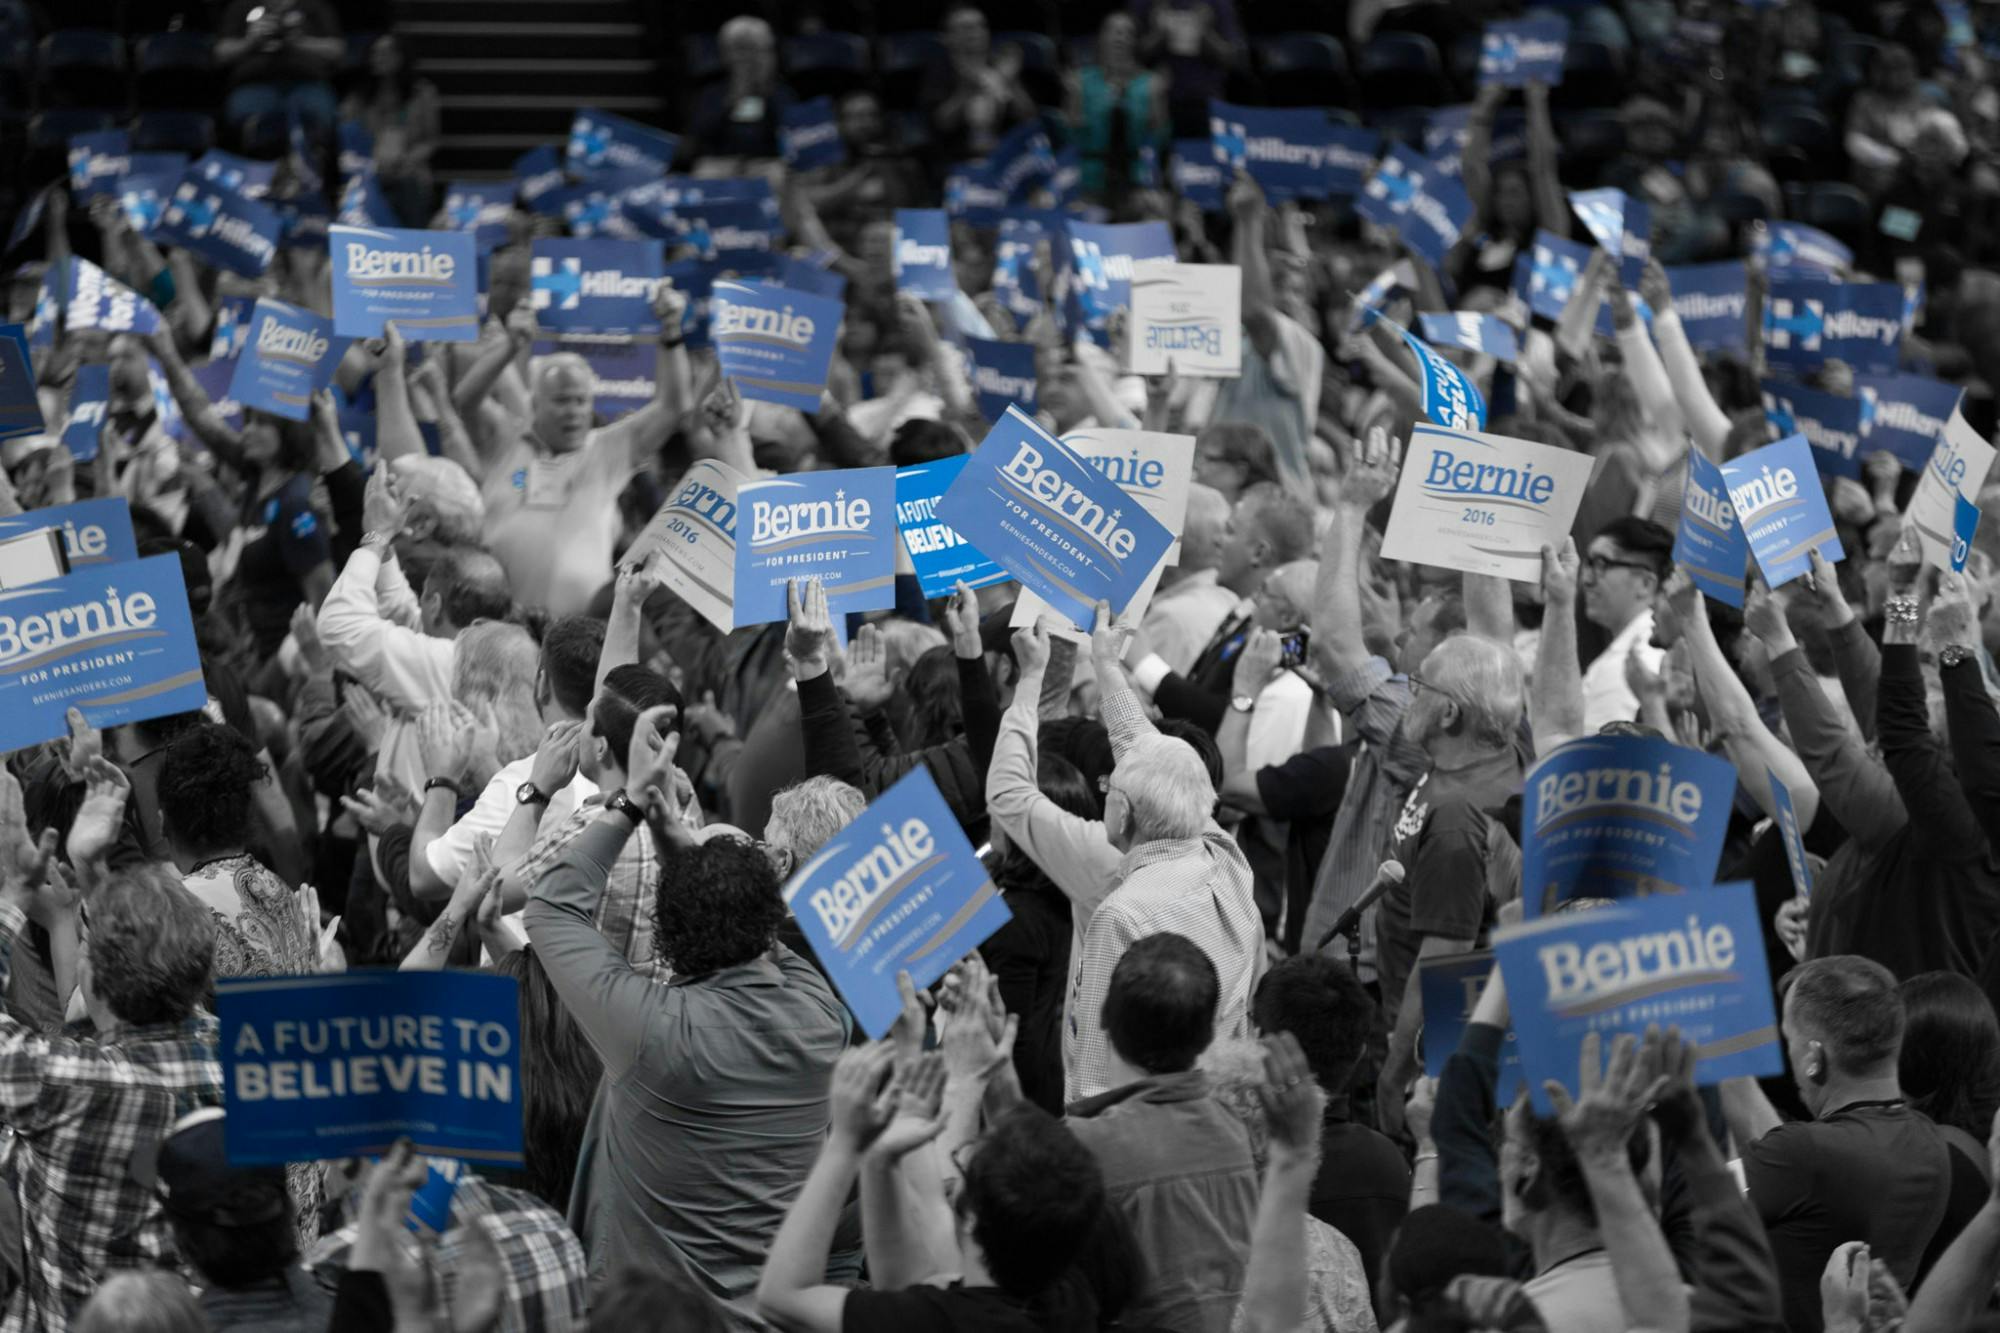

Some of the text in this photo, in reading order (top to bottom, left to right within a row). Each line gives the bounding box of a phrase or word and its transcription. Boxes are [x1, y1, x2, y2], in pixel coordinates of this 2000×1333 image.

[1247, 134, 1322, 169] Hillary
[346, 242, 456, 280] Bernie
[580, 269, 670, 304] Hillary
[257, 316, 329, 362] Bernie
[1146, 325, 1223, 357] Bernie
[1425, 450, 1554, 504] Bernie
[752, 488, 871, 542] Bernie
[896, 503, 908, 525] A
[1002, 440, 1136, 560] Bernie
[1462, 508, 1495, 526] 2016
[666, 517, 700, 545] 2016
[1000, 519, 1076, 578] BERNIESANDERS.COM
[1005, 499, 1093, 567] FOR PRESIDENT
[766, 550, 848, 567] FOR PRESIDENT
[0, 586, 158, 659] Bernie
[20, 651, 135, 687] FOR PRESIDENT
[32, 675, 133, 705] BERNIESANDERS.COM
[1536, 763, 1703, 825] Bernie
[1573, 826, 1666, 847] PRESIDENT
[809, 818, 935, 940] Bernie
[871, 884, 934, 942] PRESIDENT
[1540, 914, 1736, 1003] Bernie
[234, 1015, 512, 1057] A FUTURE TO
[235, 1055, 513, 1104] BELIEVE IN
